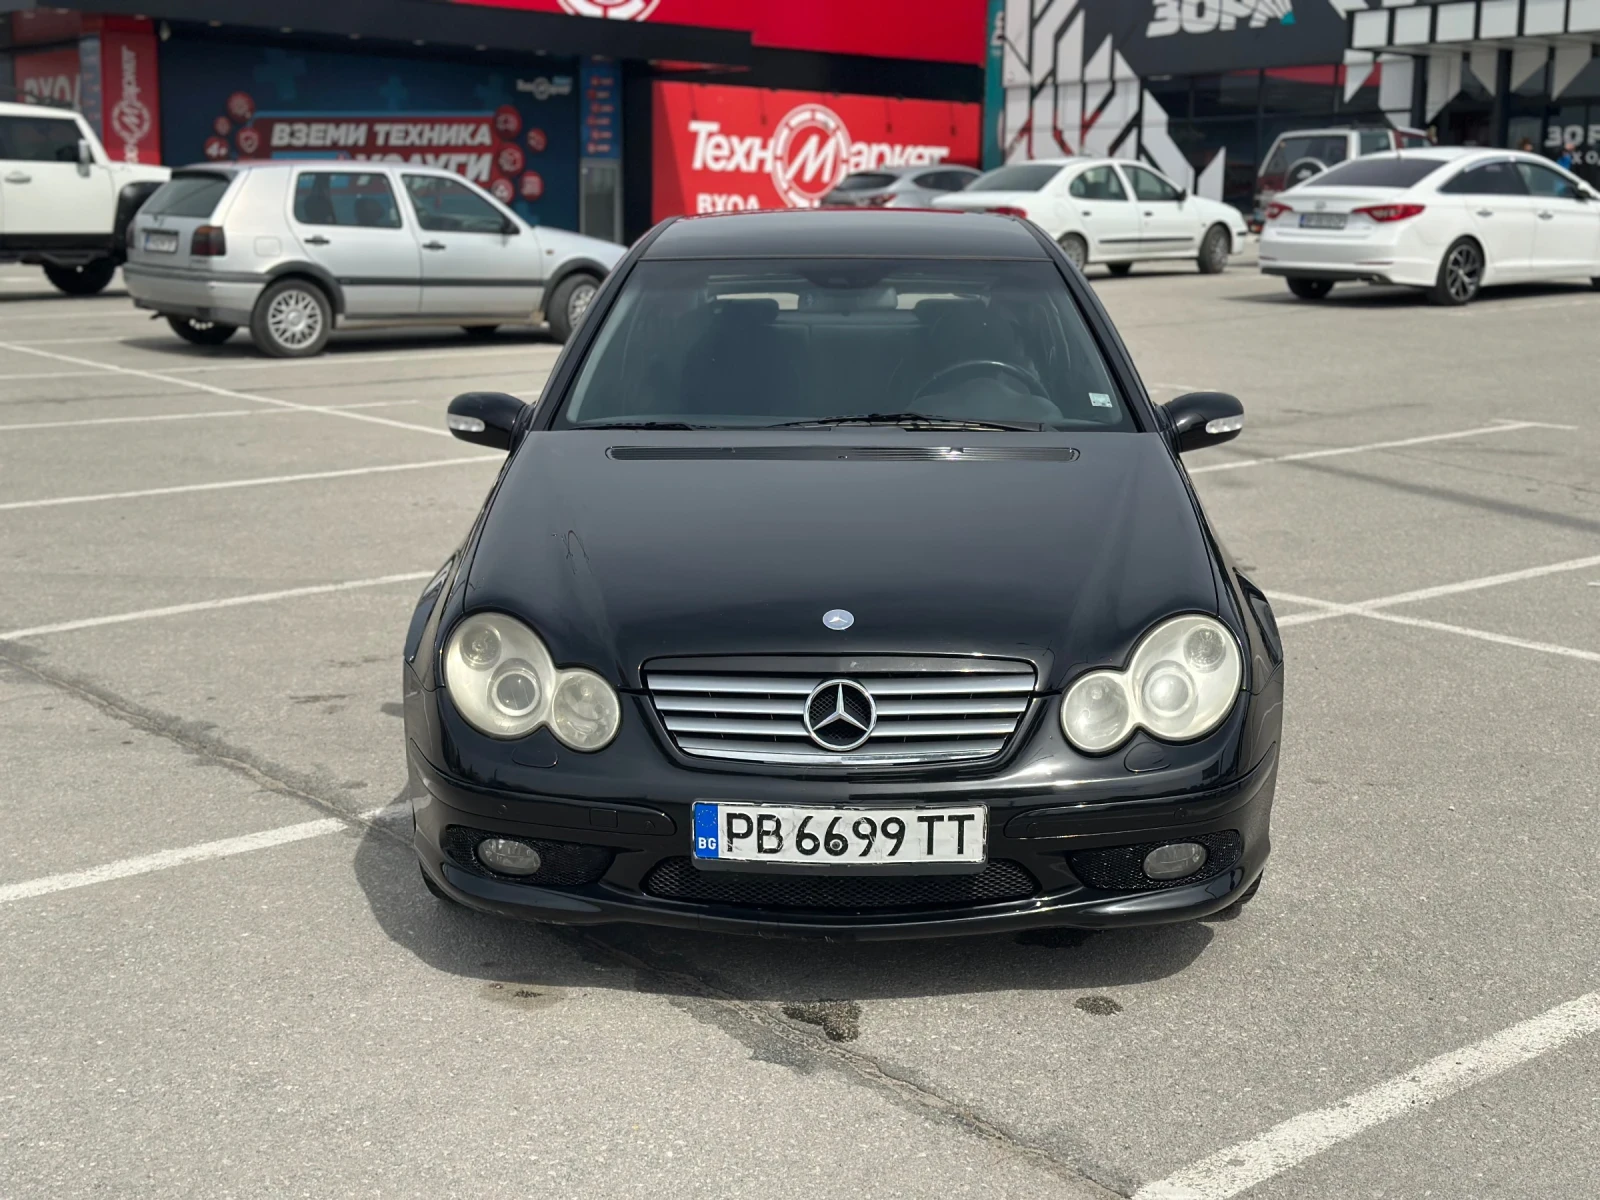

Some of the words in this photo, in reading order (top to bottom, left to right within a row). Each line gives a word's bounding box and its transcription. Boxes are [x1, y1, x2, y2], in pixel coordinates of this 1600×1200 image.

[271, 123, 369, 147] ВЗЕМИ
[373, 123, 492, 147] ТЕХНИКА
[698, 837, 717, 850] BG
[726, 812, 784, 854] PB
[795, 815, 906, 857] 6699
[917, 814, 975, 856] TT
